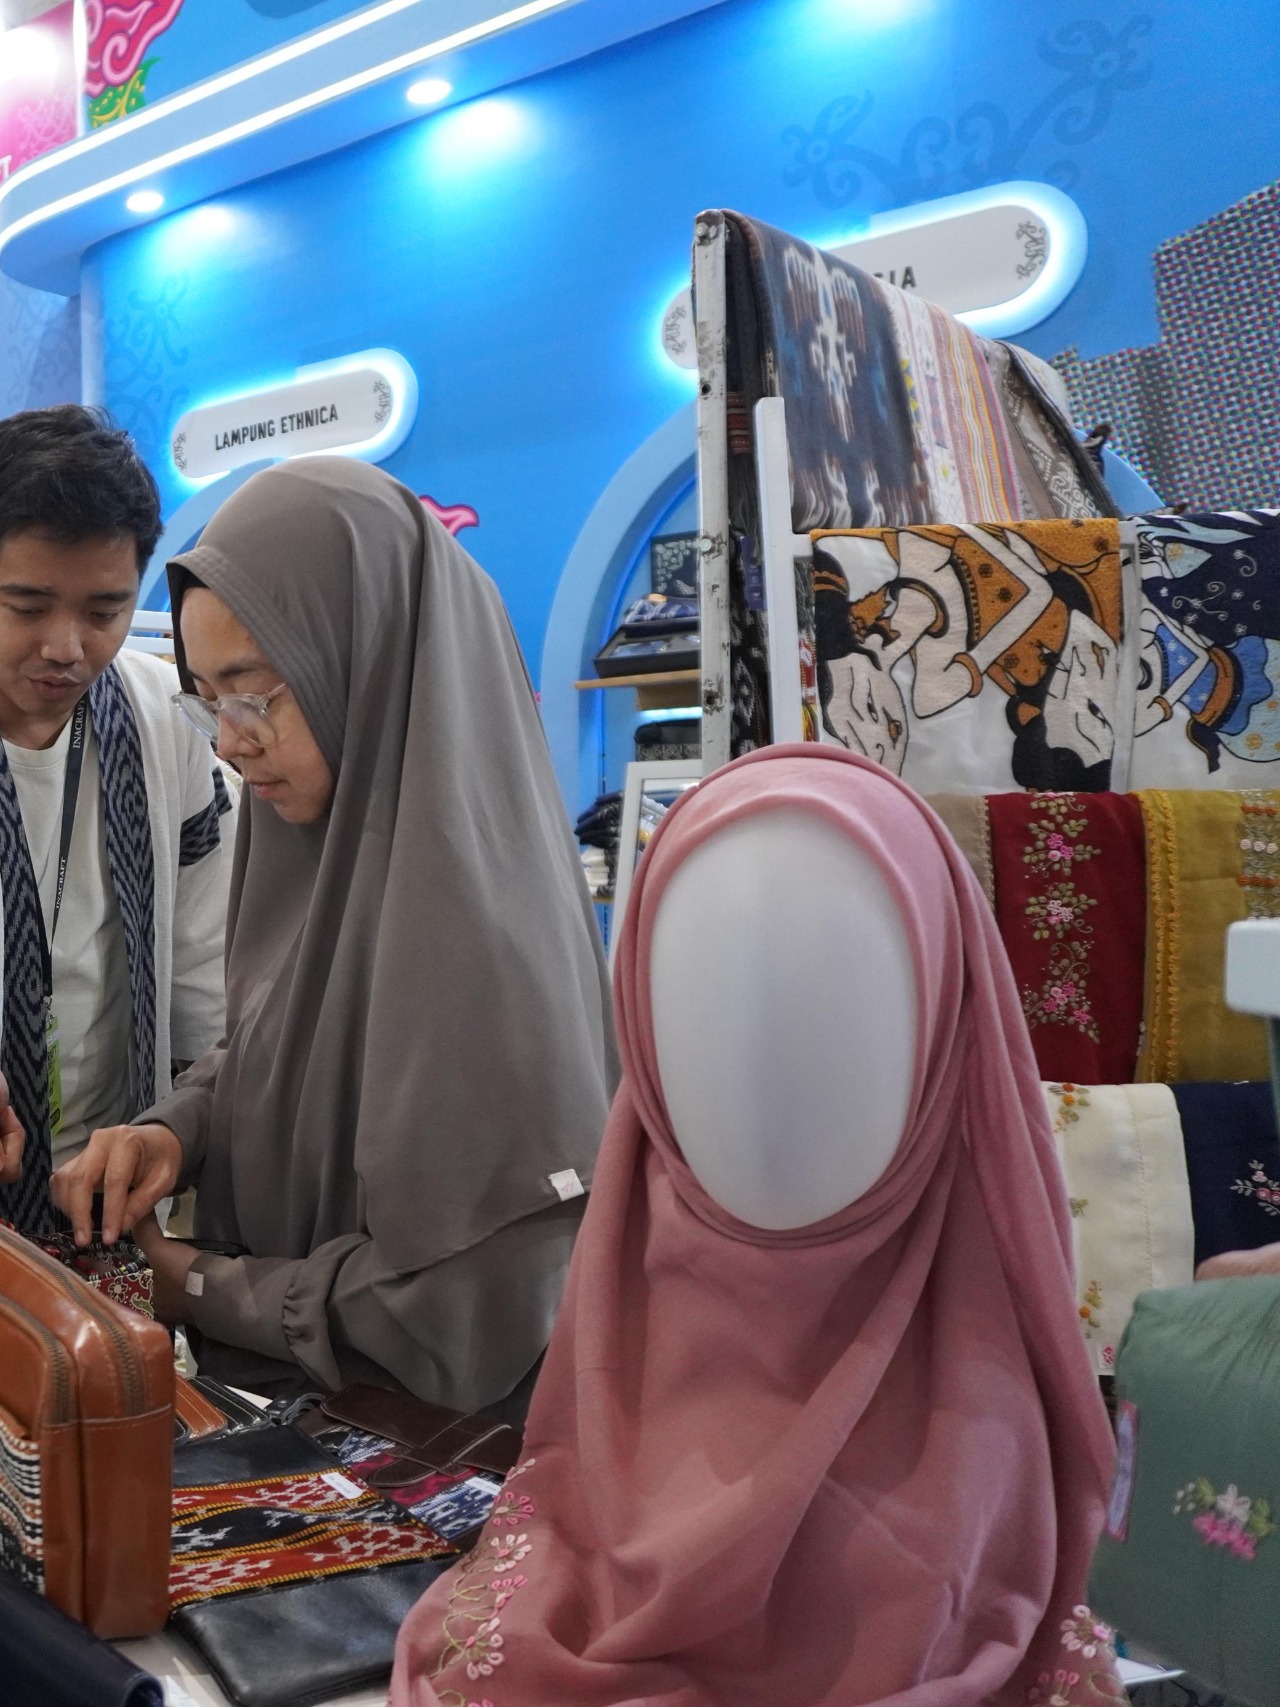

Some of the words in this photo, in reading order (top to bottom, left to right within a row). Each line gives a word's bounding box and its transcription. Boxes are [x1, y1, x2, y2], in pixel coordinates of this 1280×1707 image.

[215, 420, 276, 451] LAMPUNG
[281, 404, 339, 434] ETHNICA
[56, 857, 66, 909] INACRAFT
